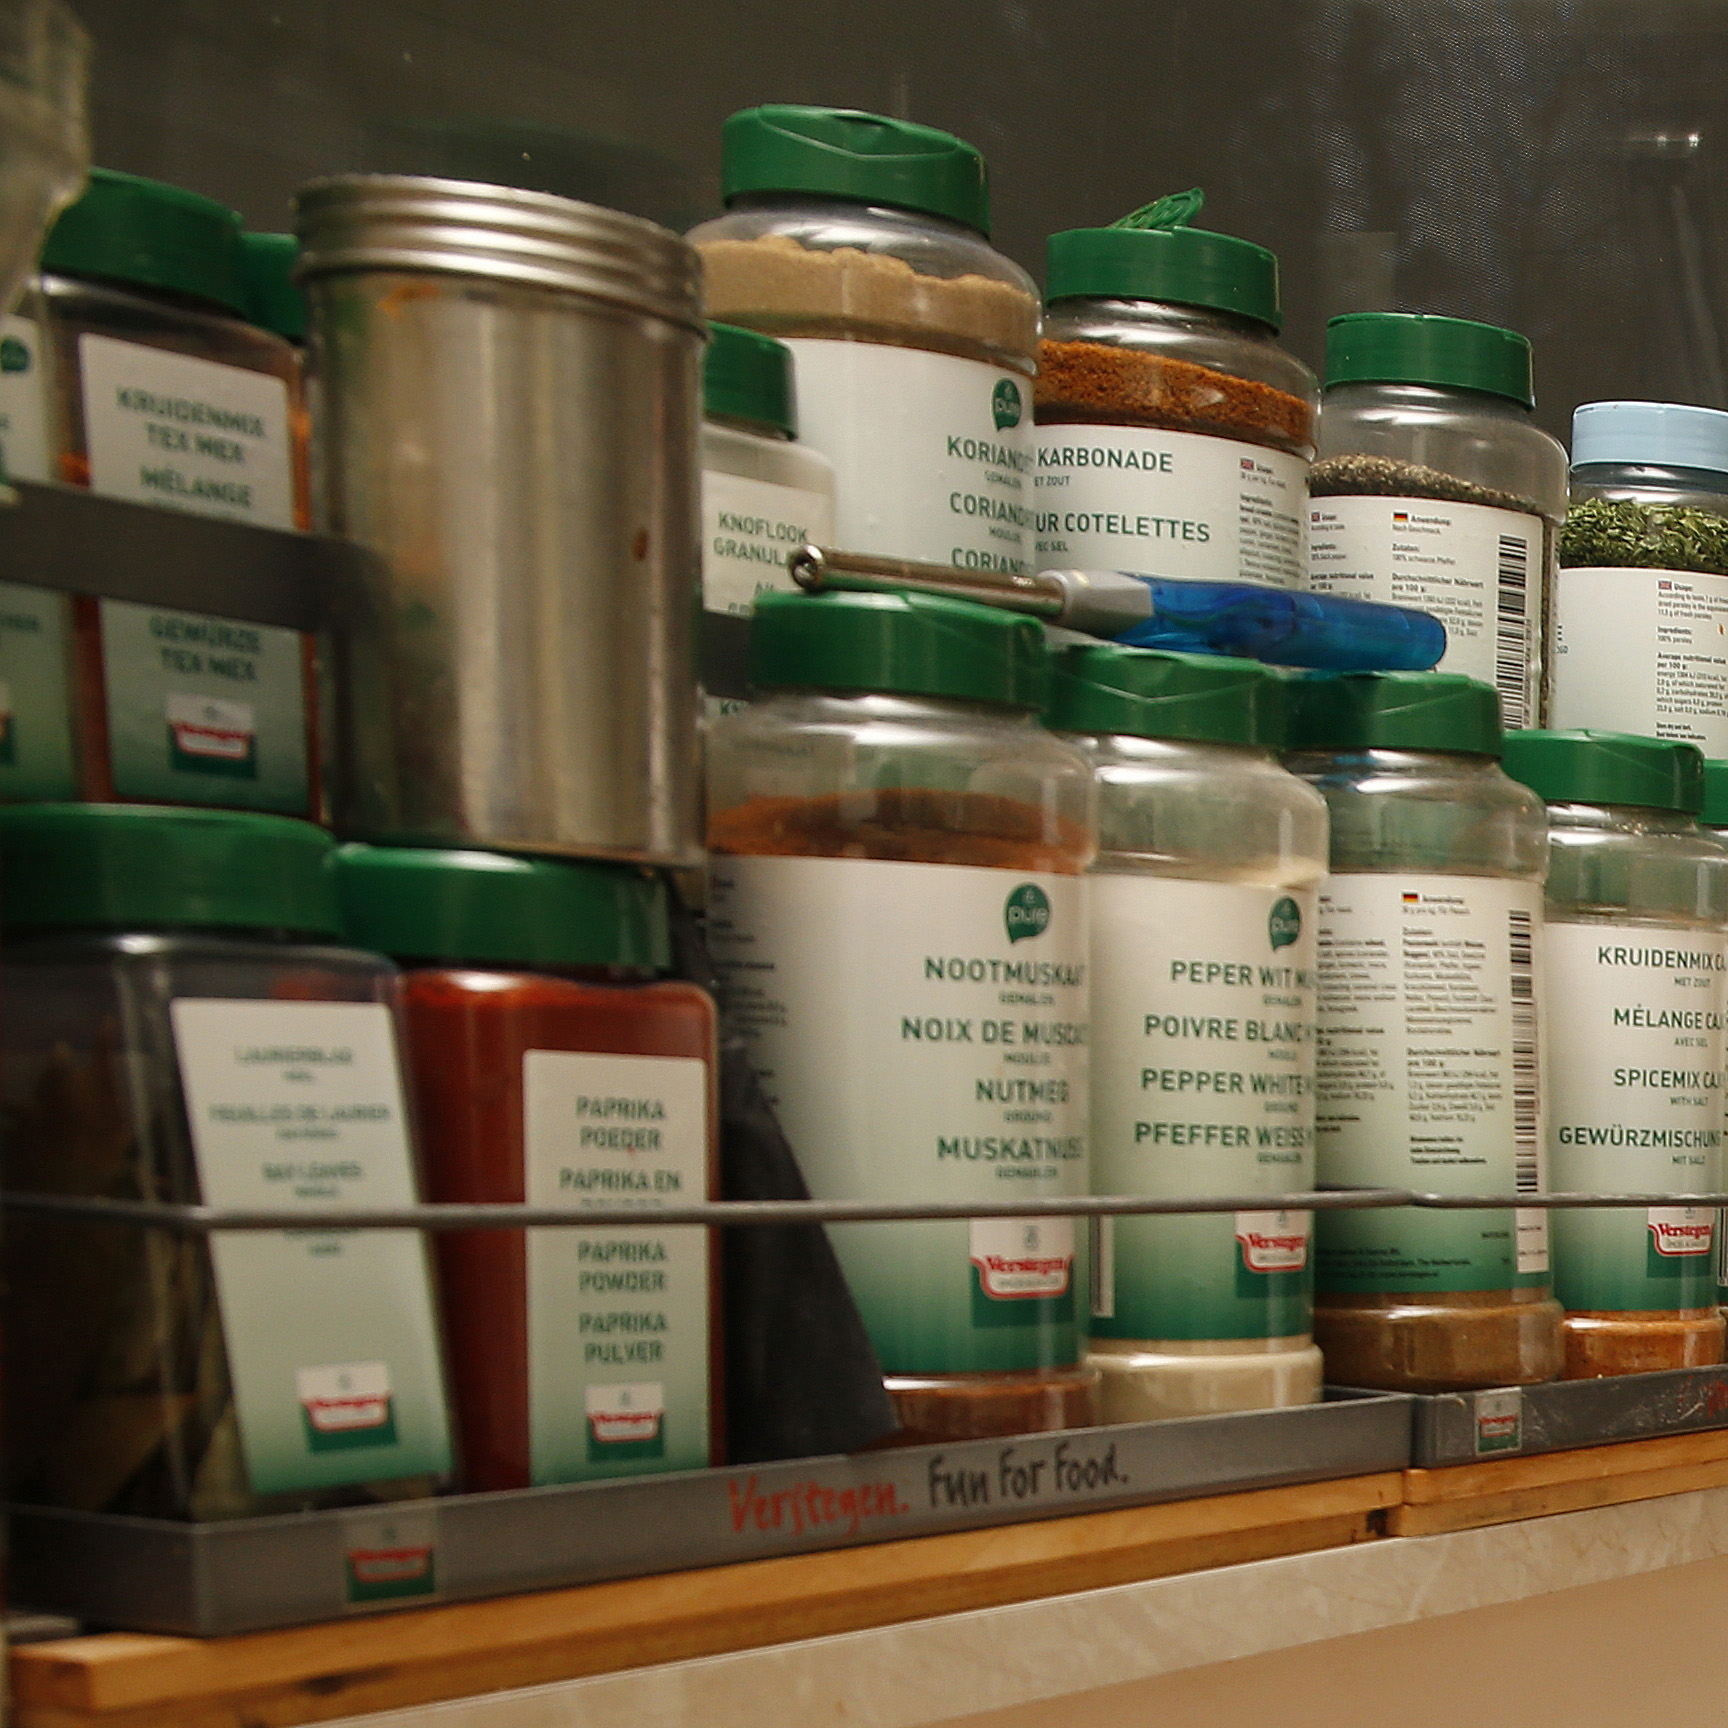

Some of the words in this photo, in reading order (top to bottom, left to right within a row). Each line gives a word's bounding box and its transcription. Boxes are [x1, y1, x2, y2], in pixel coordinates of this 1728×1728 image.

[116, 385, 266, 437] KRUIDENMIX
[147, 421, 190, 452] TEX
[1037, 447, 1174, 474] KARBONADE
[718, 511, 808, 544] KNOFLOOK
[1034, 512, 1059, 534] UR
[1064, 513, 1211, 543] COTELETTES
[1008, 904, 1050, 924] pure
[1598, 945, 1714, 970] KRUIDENMIX
[1171, 959, 1253, 986] PEPER
[901, 1014, 972, 1042] NOIX
[981, 1018, 1015, 1044] DE
[1144, 1012, 1239, 1041] POIVRE
[1613, 1002, 1703, 1030] MÉLANGE
[975, 1077, 1069, 1103] NUTMEG
[1141, 1067, 1244, 1094] PEPPER
[1613, 1067, 1700, 1089] SPICEMIX
[574, 1094, 667, 1122] PAPRIKA
[579, 1124, 662, 1152] POEDER
[1134, 1120, 1251, 1147] PFEFFER
[558, 1166, 649, 1193] PAPRIKA
[651, 1167, 682, 1193] EN
[576, 1239, 667, 1265] PAPRIKA
[578, 1269, 668, 1295] POWDER
[578, 1311, 668, 1336] PAPRIKA
[583, 1340, 663, 1365] PULVER
[927, 1453, 990, 1507] Fun
[999, 1446, 1045, 1500] For
[1053, 1440, 1130, 1494] Food.
